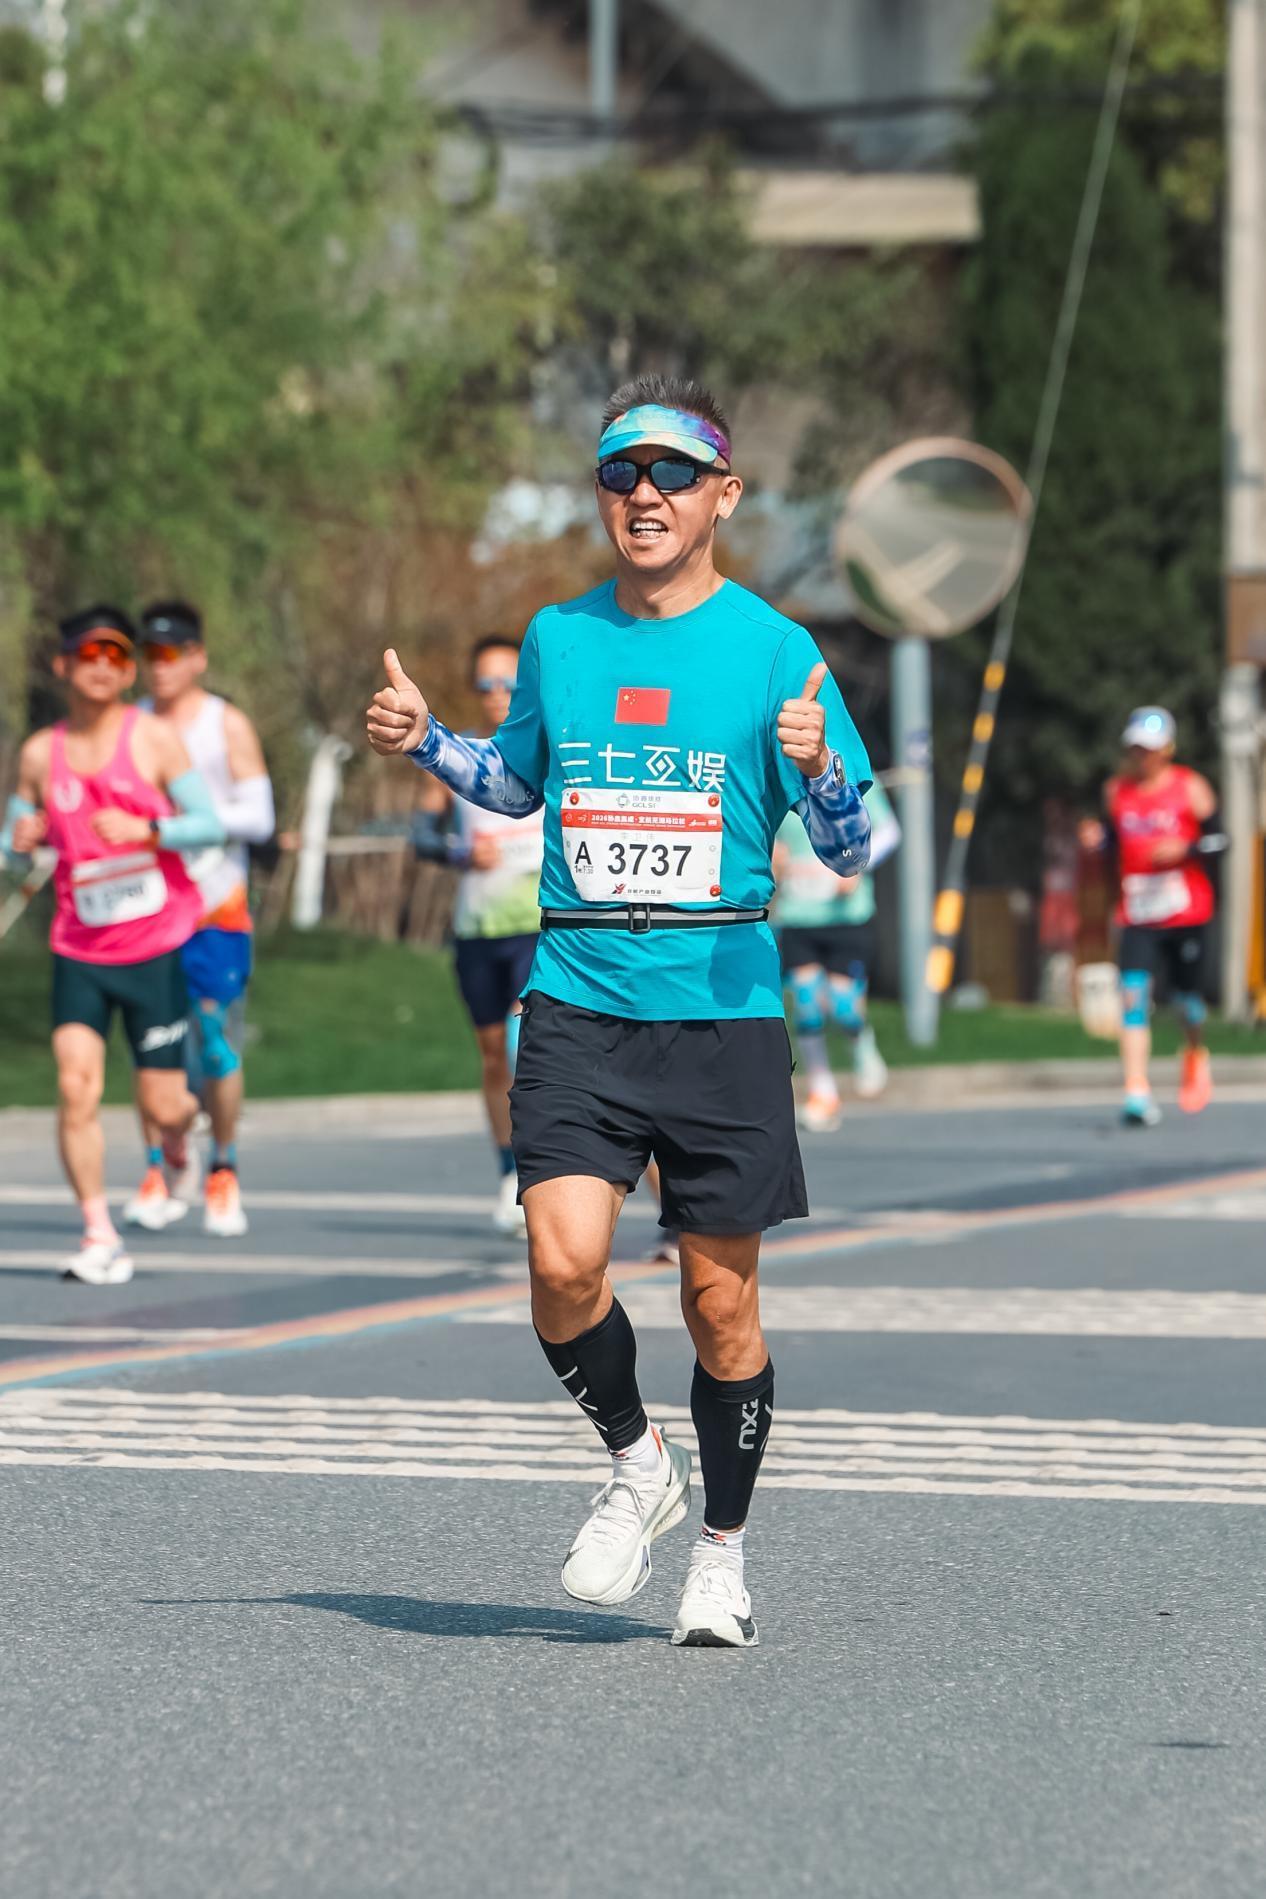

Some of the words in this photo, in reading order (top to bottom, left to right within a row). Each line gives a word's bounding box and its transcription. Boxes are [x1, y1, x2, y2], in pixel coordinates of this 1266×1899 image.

[558, 742, 727, 792] 三七互娱
[575, 841, 592, 865] A
[607, 842, 692, 877] 3737
